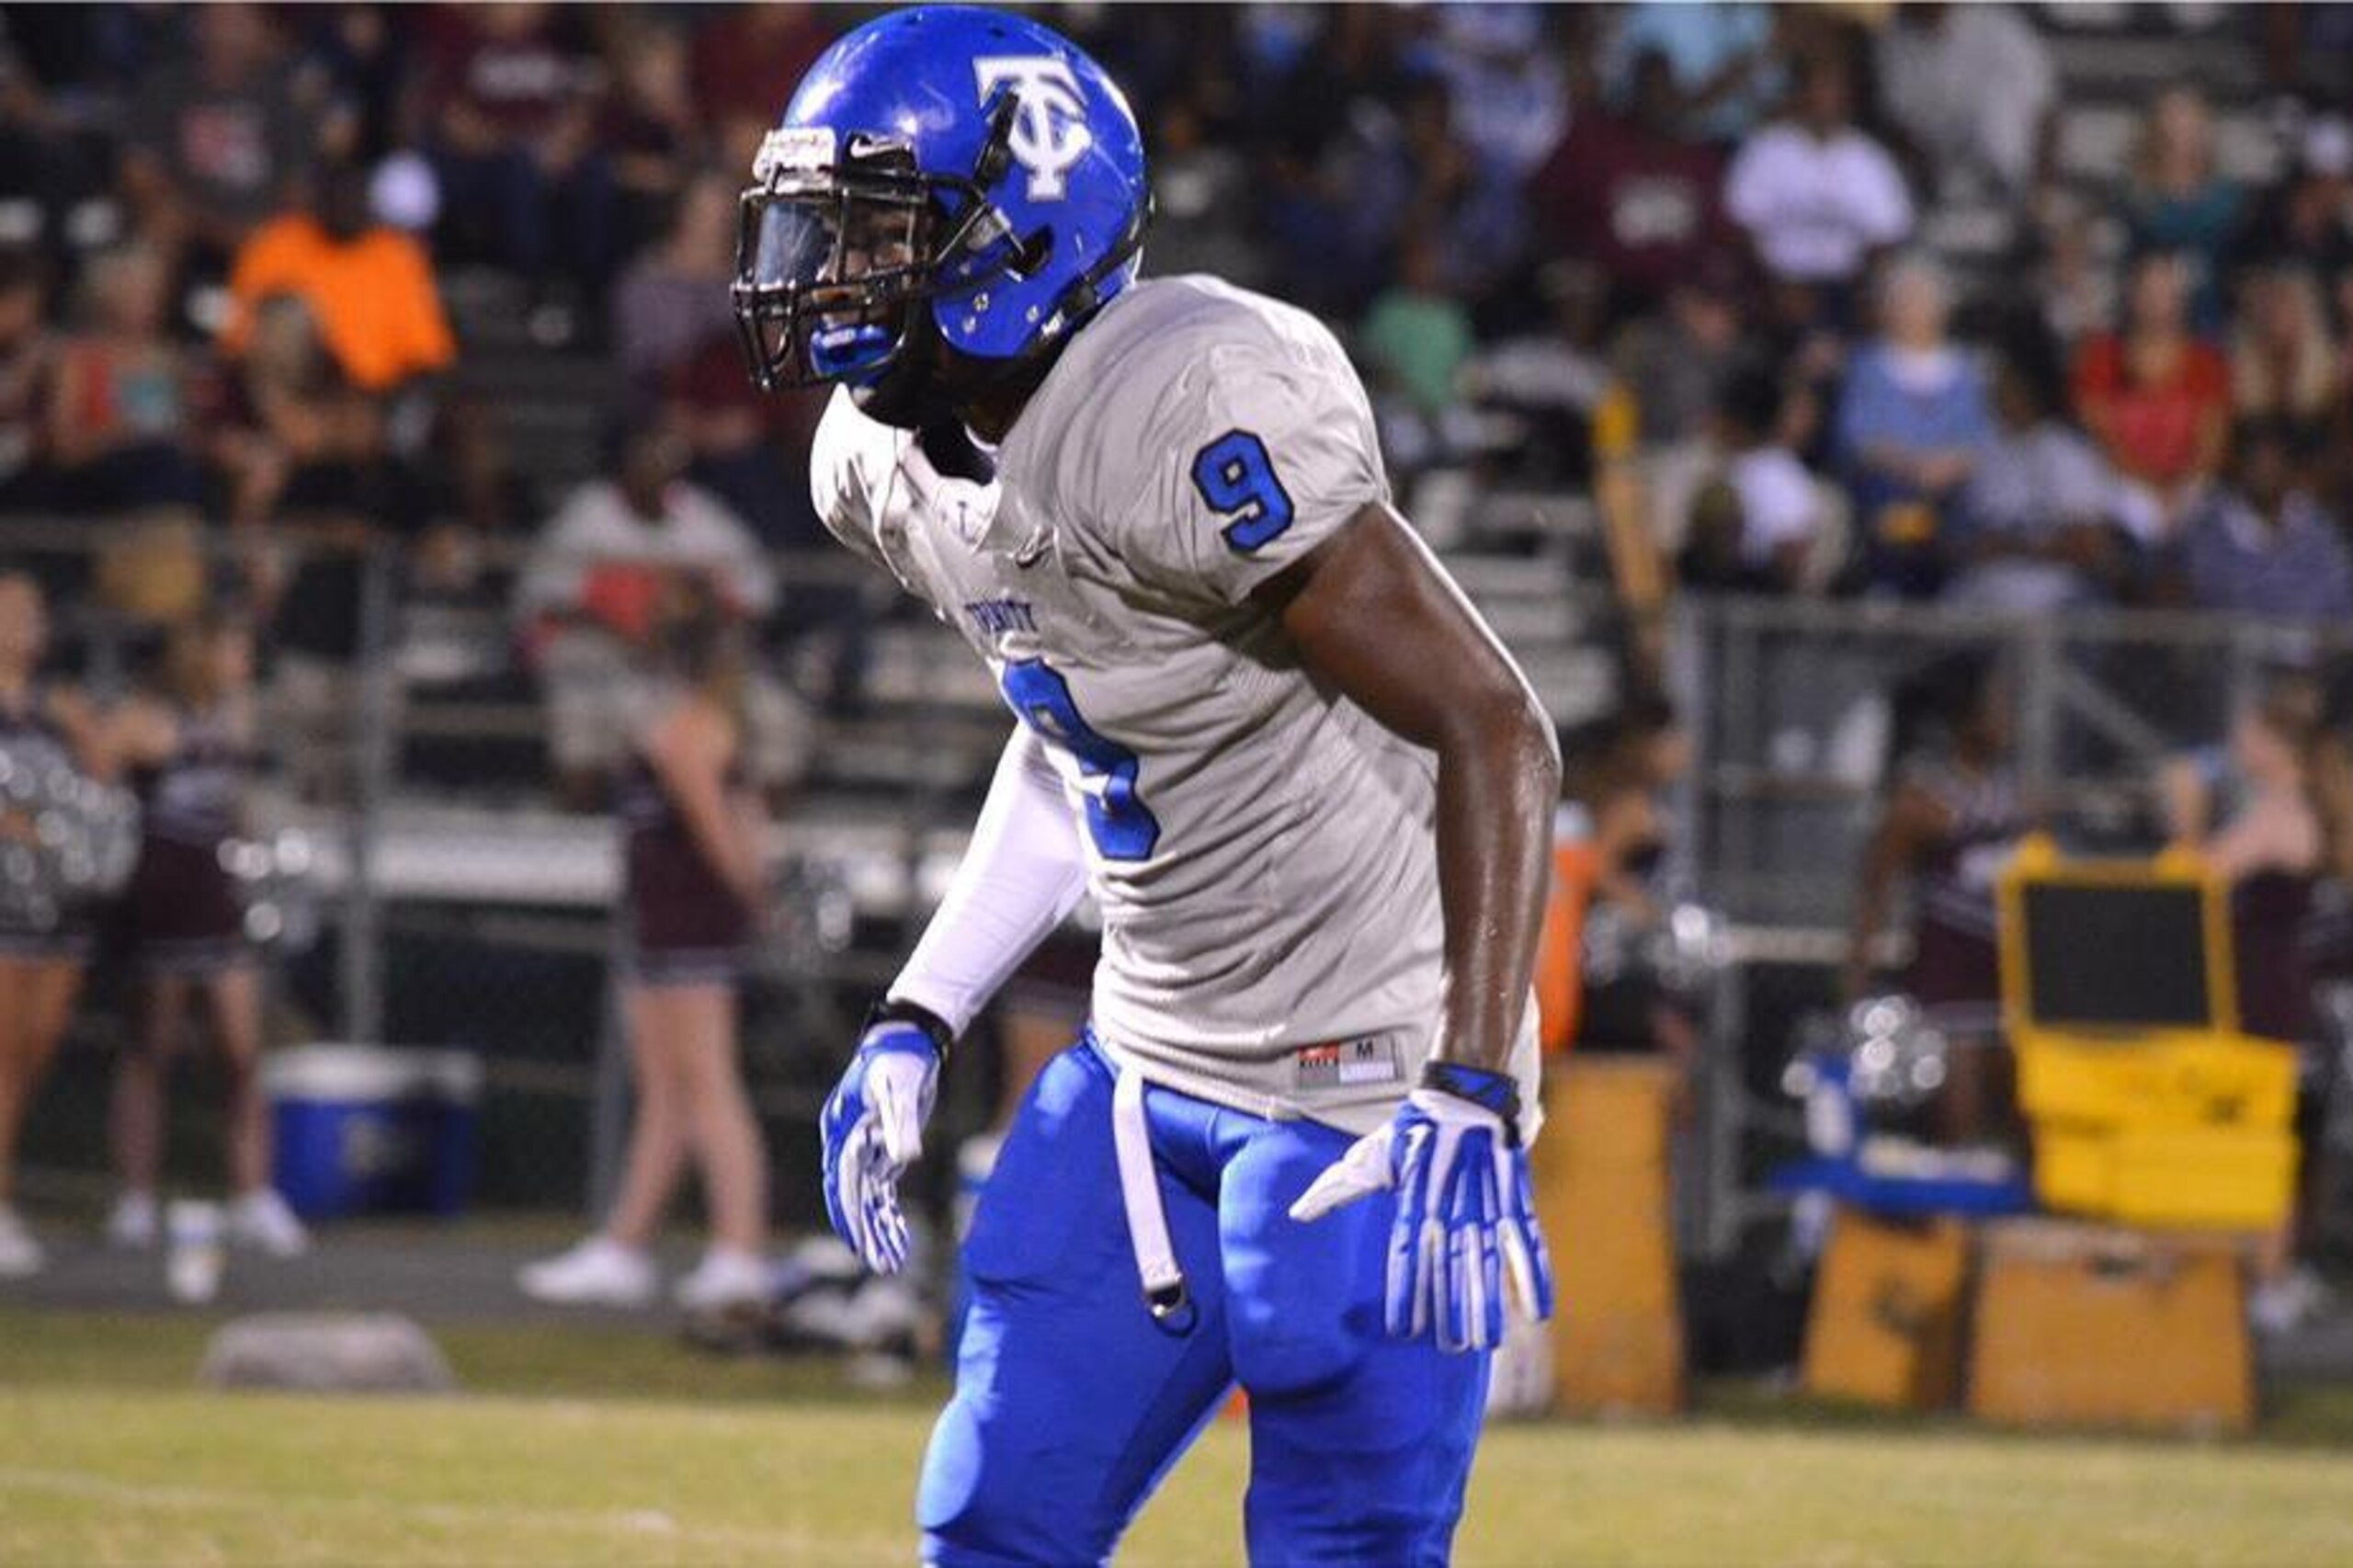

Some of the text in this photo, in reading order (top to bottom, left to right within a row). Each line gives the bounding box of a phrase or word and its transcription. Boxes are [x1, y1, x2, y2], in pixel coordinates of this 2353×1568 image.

[1190, 427, 1295, 555] 9
[1003, 655, 1161, 861] 9
[1356, 1040, 1373, 1060] M
